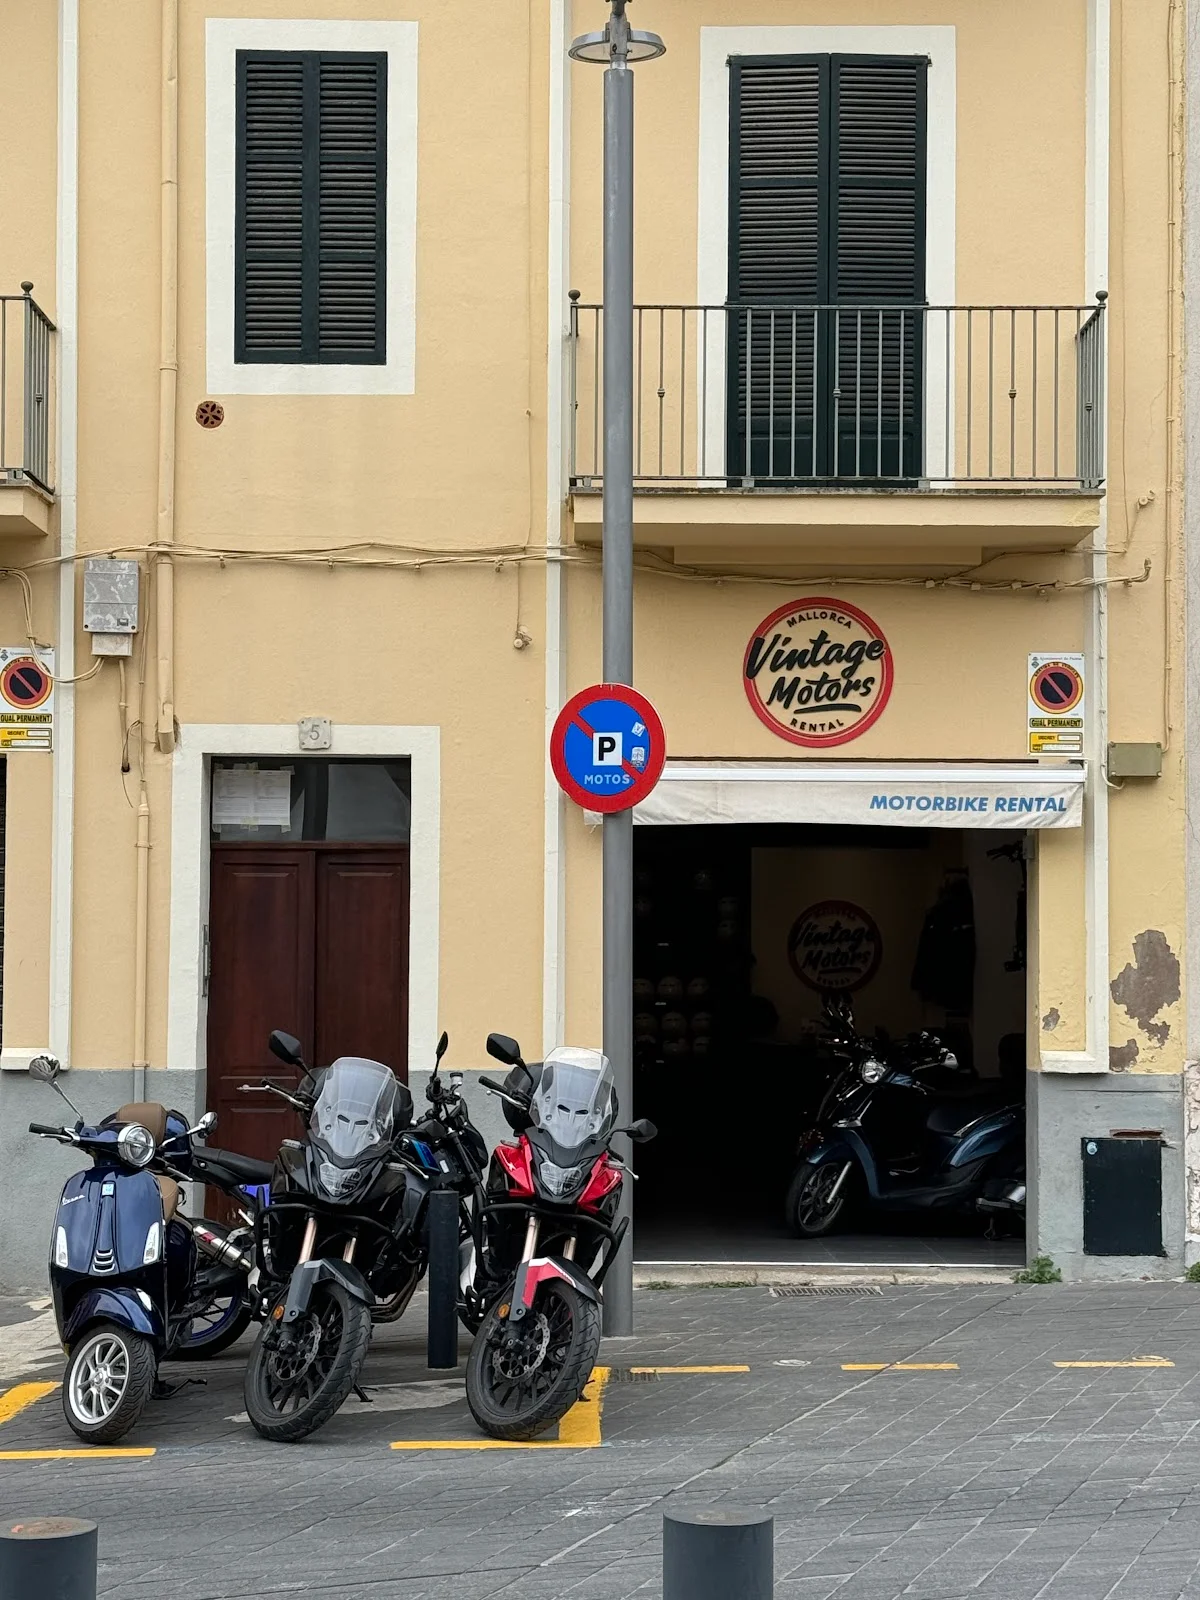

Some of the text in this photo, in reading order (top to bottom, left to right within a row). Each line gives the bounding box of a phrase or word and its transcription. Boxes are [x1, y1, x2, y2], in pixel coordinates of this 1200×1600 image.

[786, 611, 852, 629] MALLORCA
[745, 630, 886, 679] Vintage
[766, 671, 876, 710] Motors
[17, 714, 50, 722] PERMANENT
[790, 718, 844, 732] RENTAL
[1032, 719, 1081, 727] GUAL PERMANENT
[310, 724, 320, 741] 5
[598, 736, 616, 761] P
[584, 774, 631, 785] MOTOS
[870, 795, 1068, 812] MOTORBIKE RENTAL
[788, 920, 875, 952] Vintage
[801, 944, 871, 970] Motors
